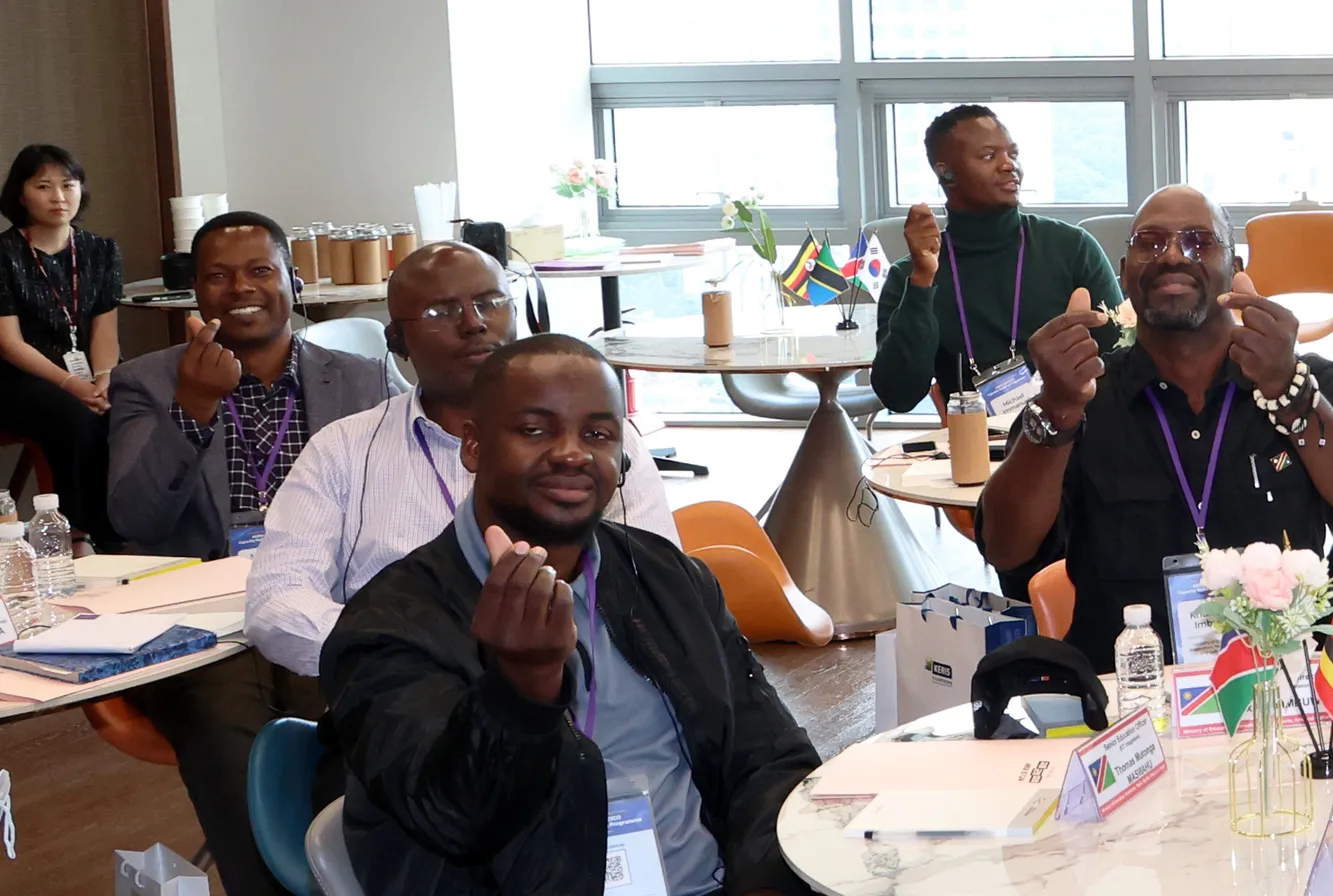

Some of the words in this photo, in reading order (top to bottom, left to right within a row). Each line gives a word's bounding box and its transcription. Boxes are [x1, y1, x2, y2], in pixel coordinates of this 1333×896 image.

[933, 664, 951, 677] KERIS
[1116, 727, 1135, 743] Education
[1134, 718, 1147, 732] Officer
[1114, 757, 1135, 776] Thomas
